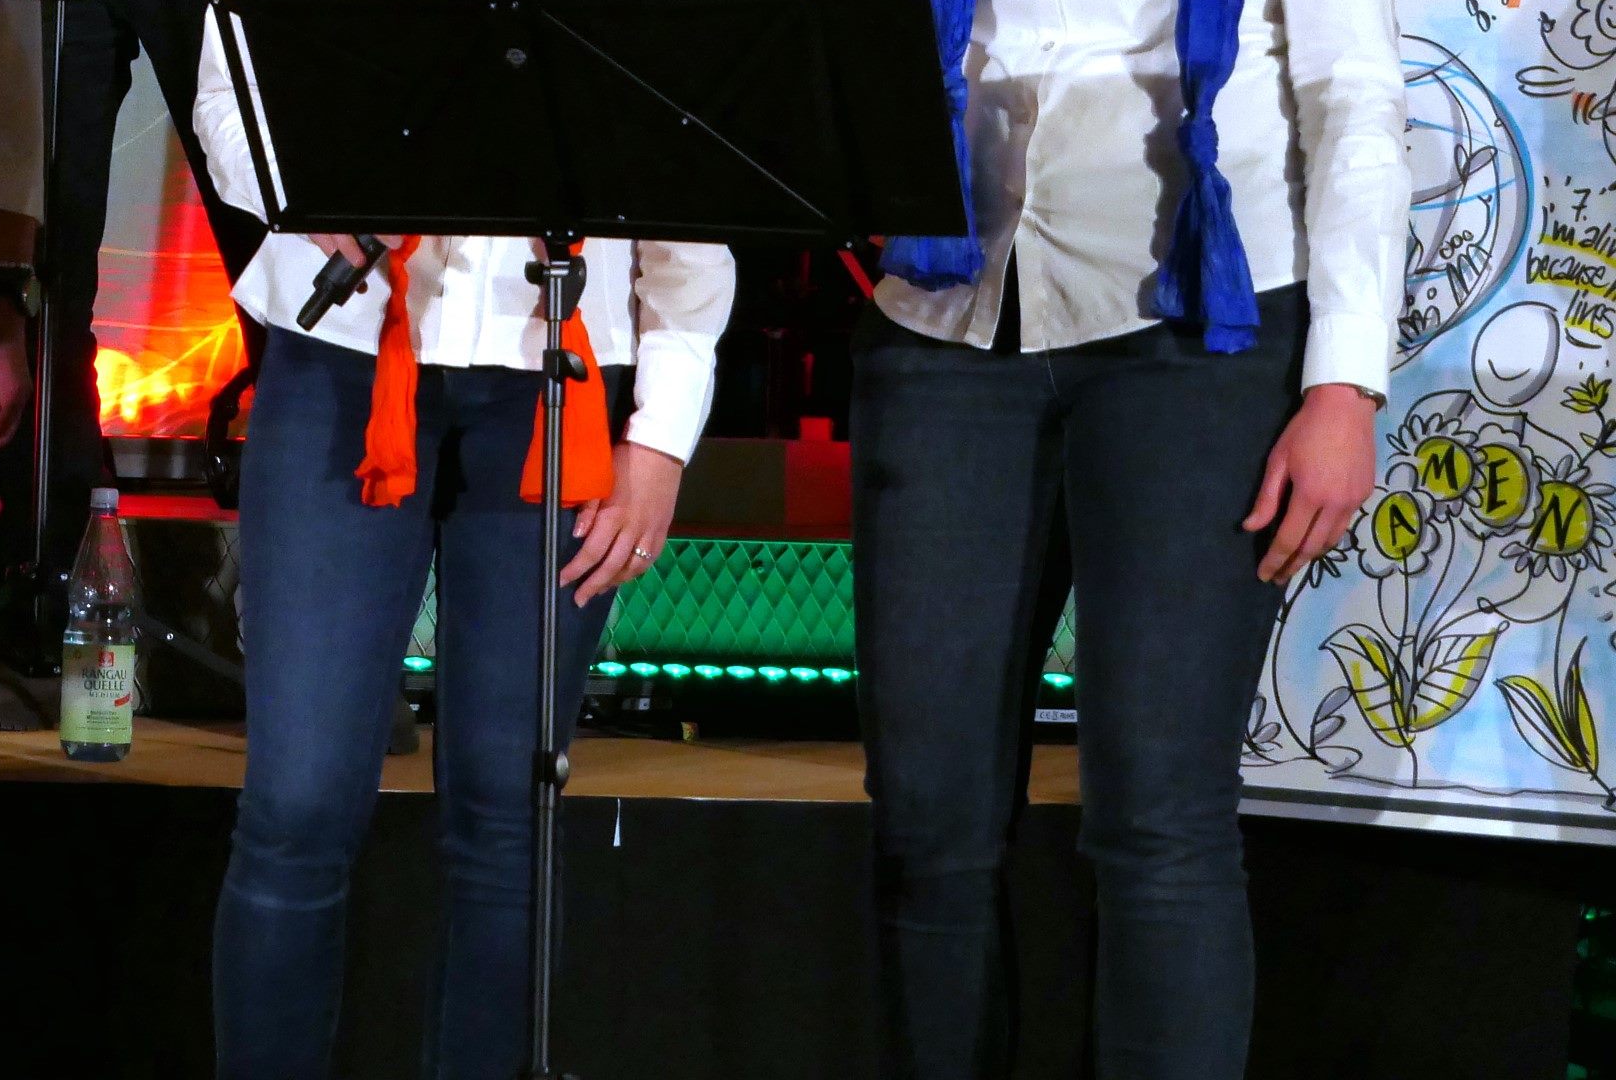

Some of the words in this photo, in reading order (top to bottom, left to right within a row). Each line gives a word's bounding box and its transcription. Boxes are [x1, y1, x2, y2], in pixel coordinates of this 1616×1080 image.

[1571, 187, 1591, 222] 7.
[1526, 247, 1610, 289] because
[1564, 289, 1614, 339] lives
[82, 668, 127, 680] RANGAU
[84, 680, 125, 691] QUELLE
